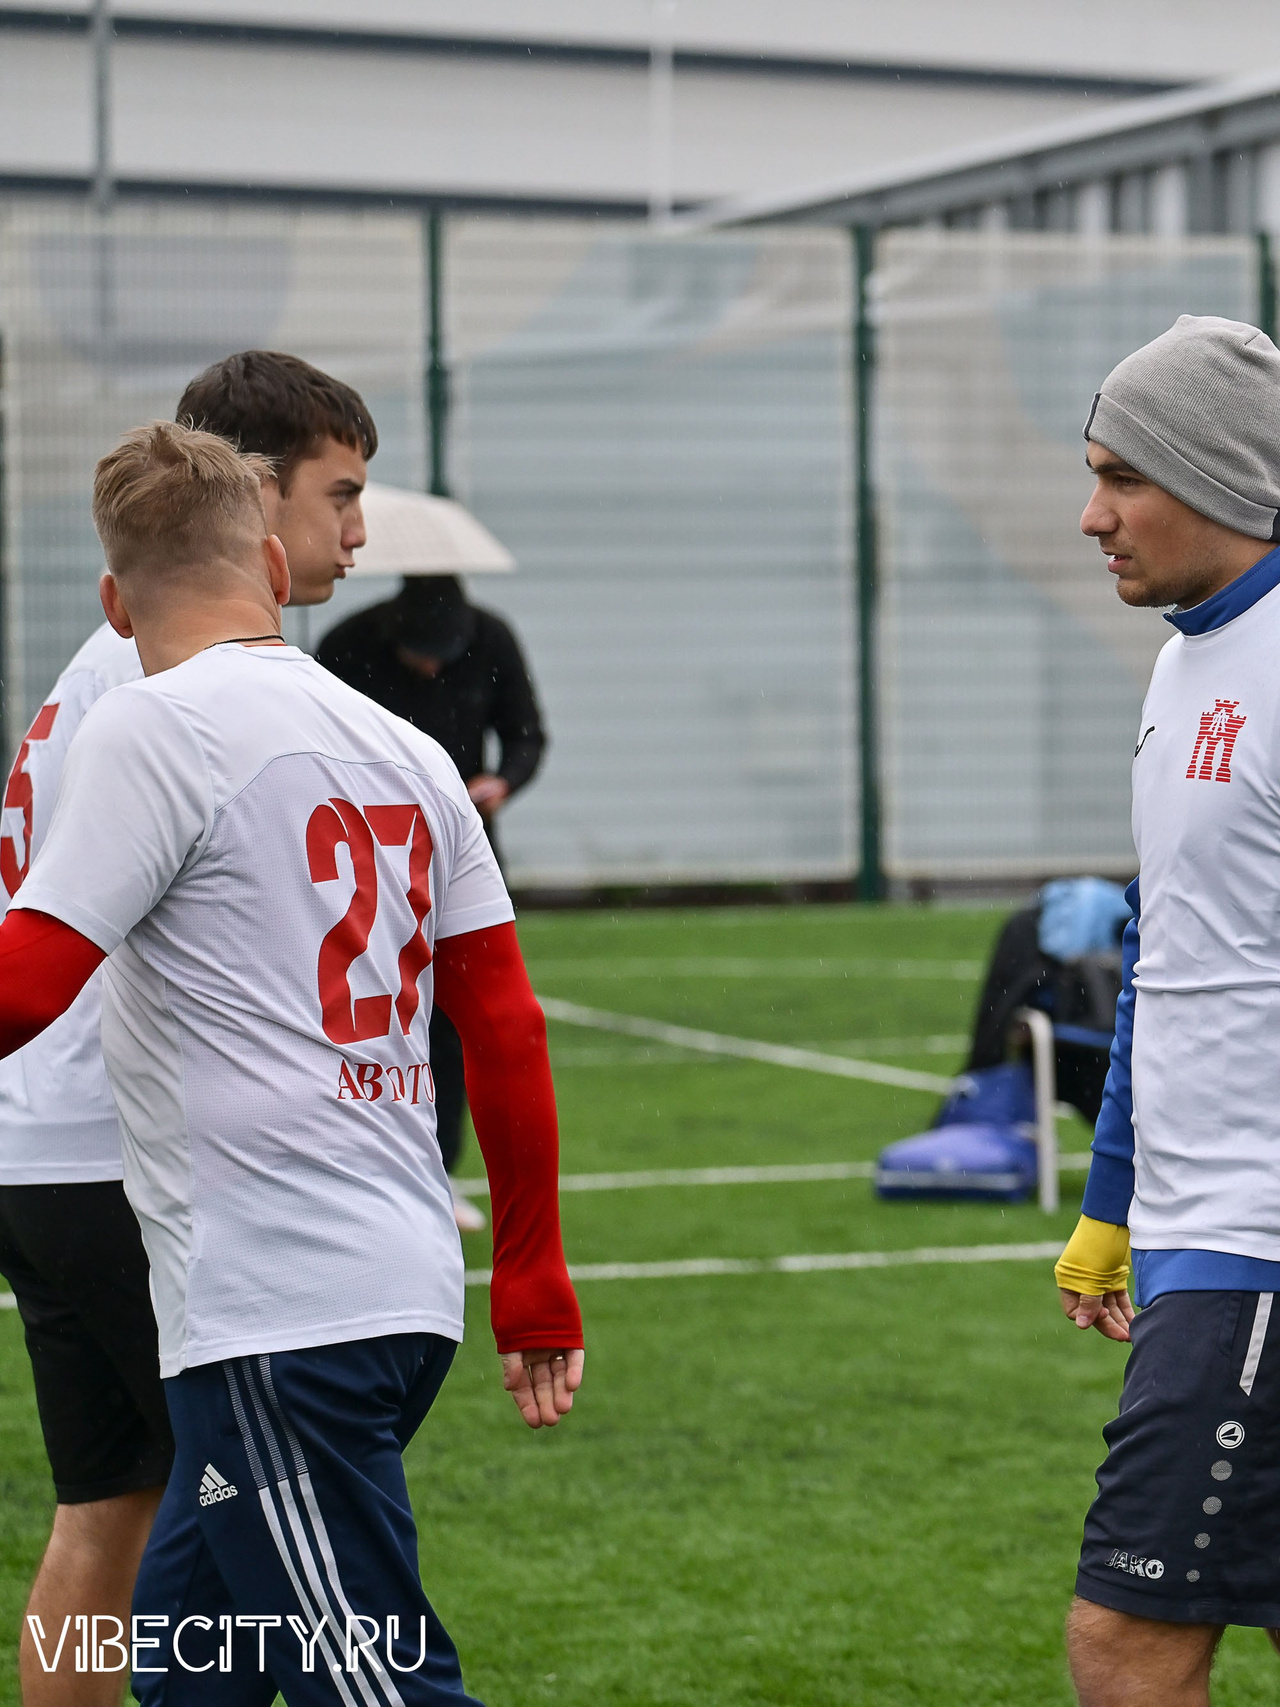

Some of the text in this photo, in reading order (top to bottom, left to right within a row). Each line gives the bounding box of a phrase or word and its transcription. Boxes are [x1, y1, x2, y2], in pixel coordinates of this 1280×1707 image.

[305, 798, 433, 1045] 27
[199, 1485, 238, 1507] adidas
[1104, 1548, 1165, 1580] JAKO
